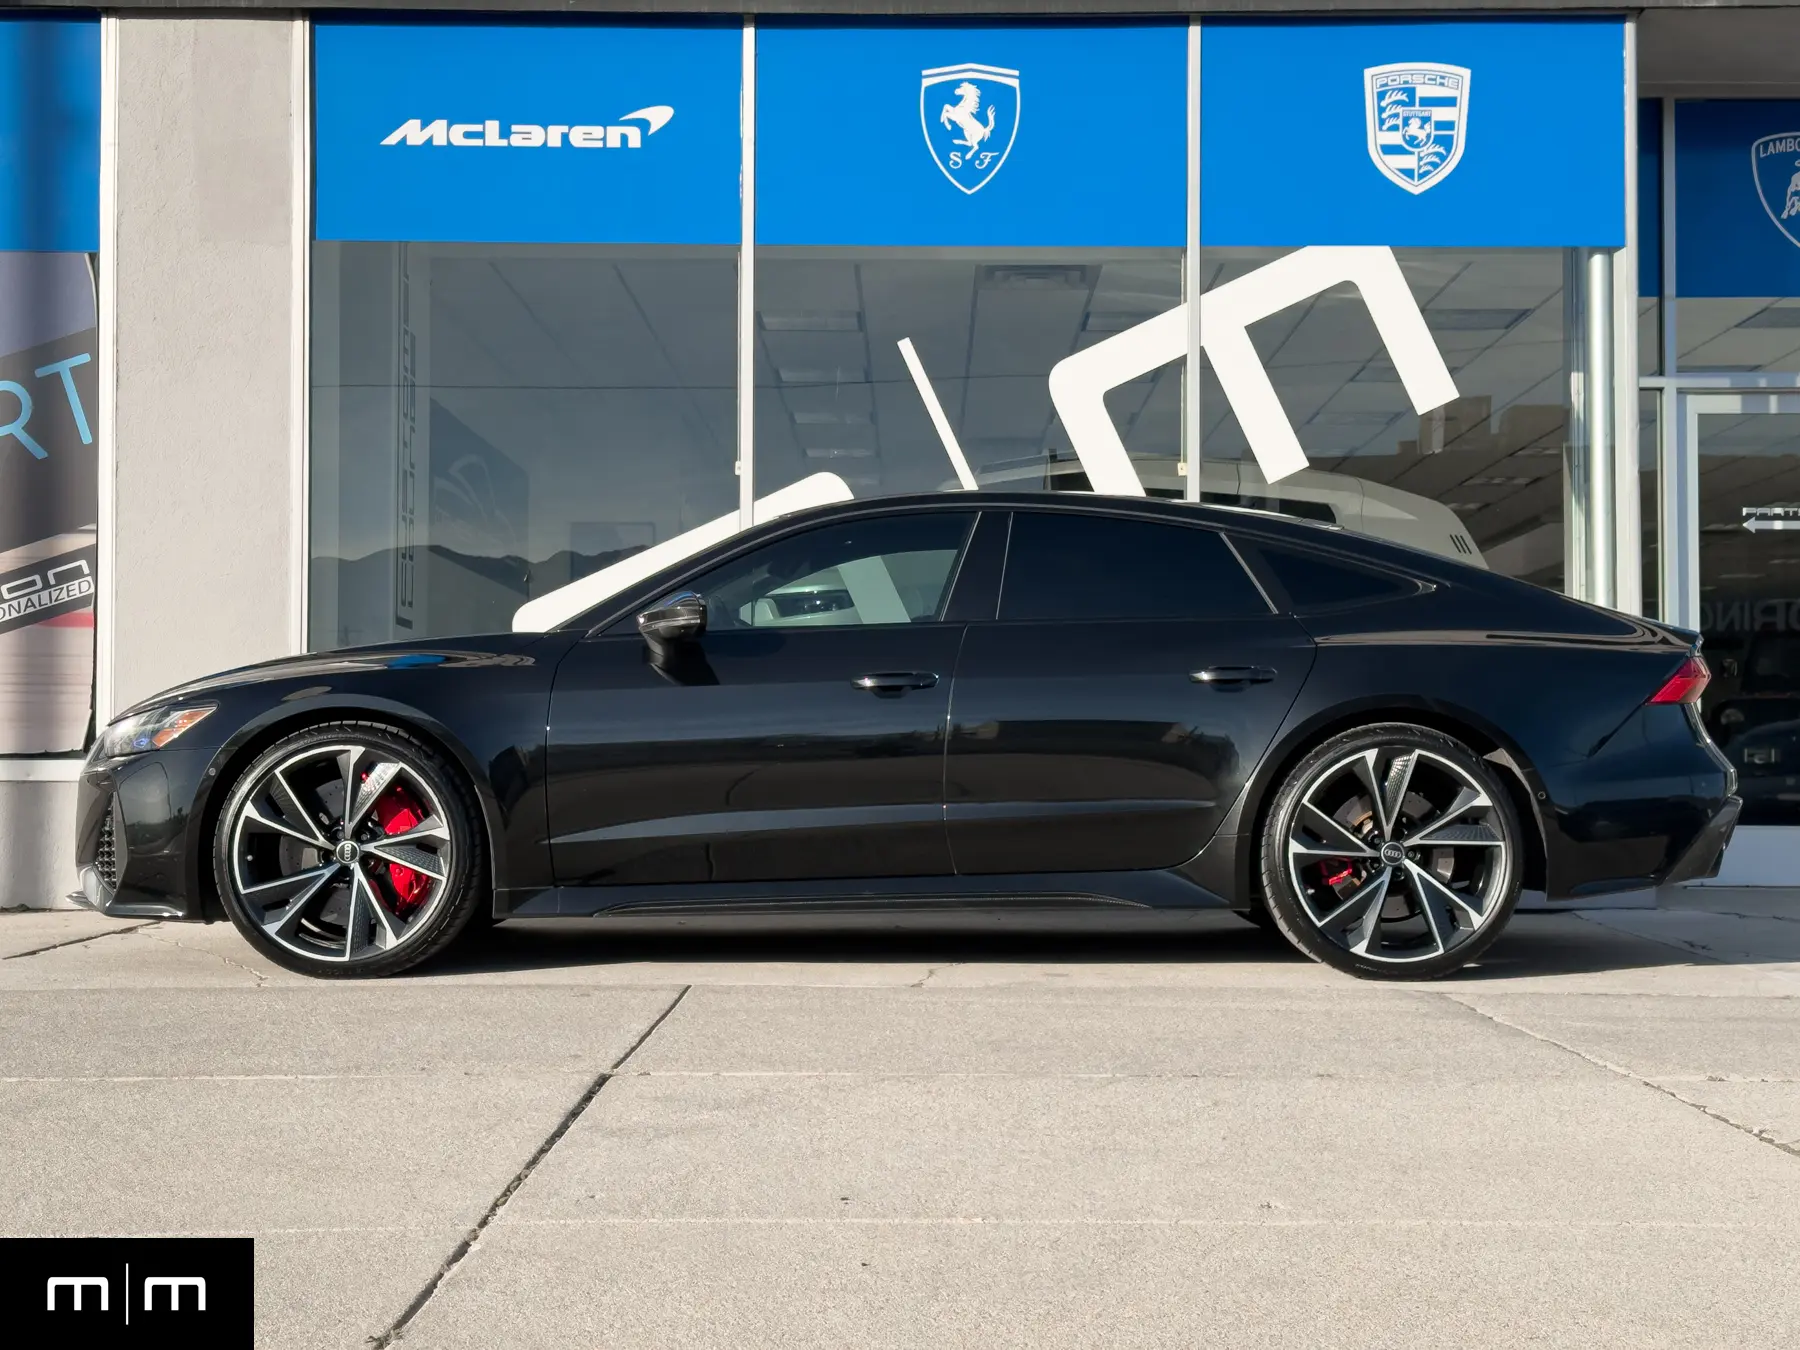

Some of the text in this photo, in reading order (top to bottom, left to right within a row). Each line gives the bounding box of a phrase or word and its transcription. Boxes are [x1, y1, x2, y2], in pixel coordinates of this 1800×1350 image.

[1377, 75, 1459, 88] PORSCHE
[379, 119, 642, 148] McLaren
[1742, 507, 1800, 517] PART
